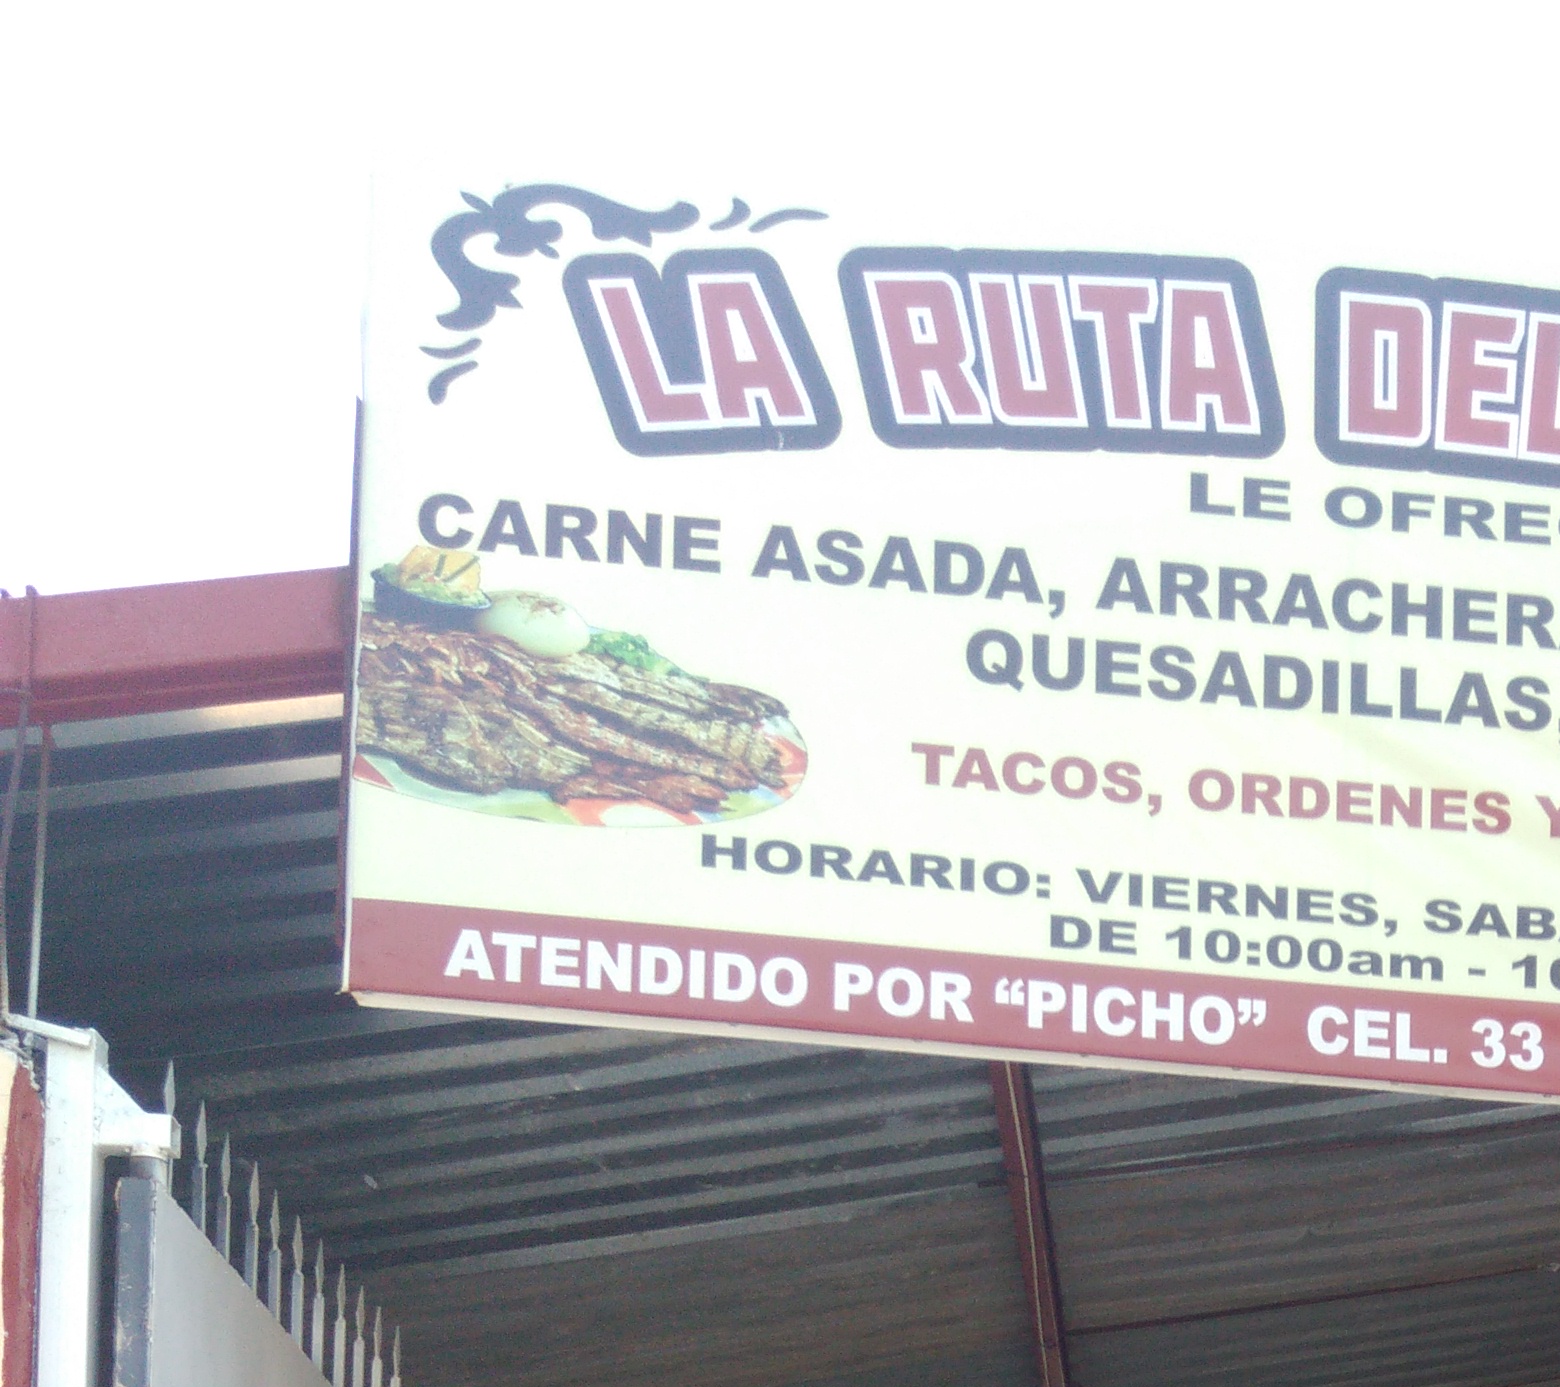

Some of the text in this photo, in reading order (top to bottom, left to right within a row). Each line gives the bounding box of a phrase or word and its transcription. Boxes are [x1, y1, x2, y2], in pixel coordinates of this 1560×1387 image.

[575, 260, 829, 444] LA
[851, 257, 1273, 447] RUTA
[1189, 473, 1291, 521] LE
[418, 493, 721, 574] CARNE
[751, 530, 1065, 618] ASADA,
[911, 743, 1162, 816] TACOS,
[1188, 769, 1511, 837] ORDENES
[701, 835, 1050, 899] HORARIO:
[1076, 868, 1396, 936] VIERNES,
[445, 928, 807, 1009] ATENDIDO
[834, 962, 973, 1022] POR
[1307, 1007, 1449, 1065] CEL.
[1471, 1019, 1545, 1069] 33
[1049, 915, 1140, 955] DE
[1166, 924, 1443, 981] 10:00am
